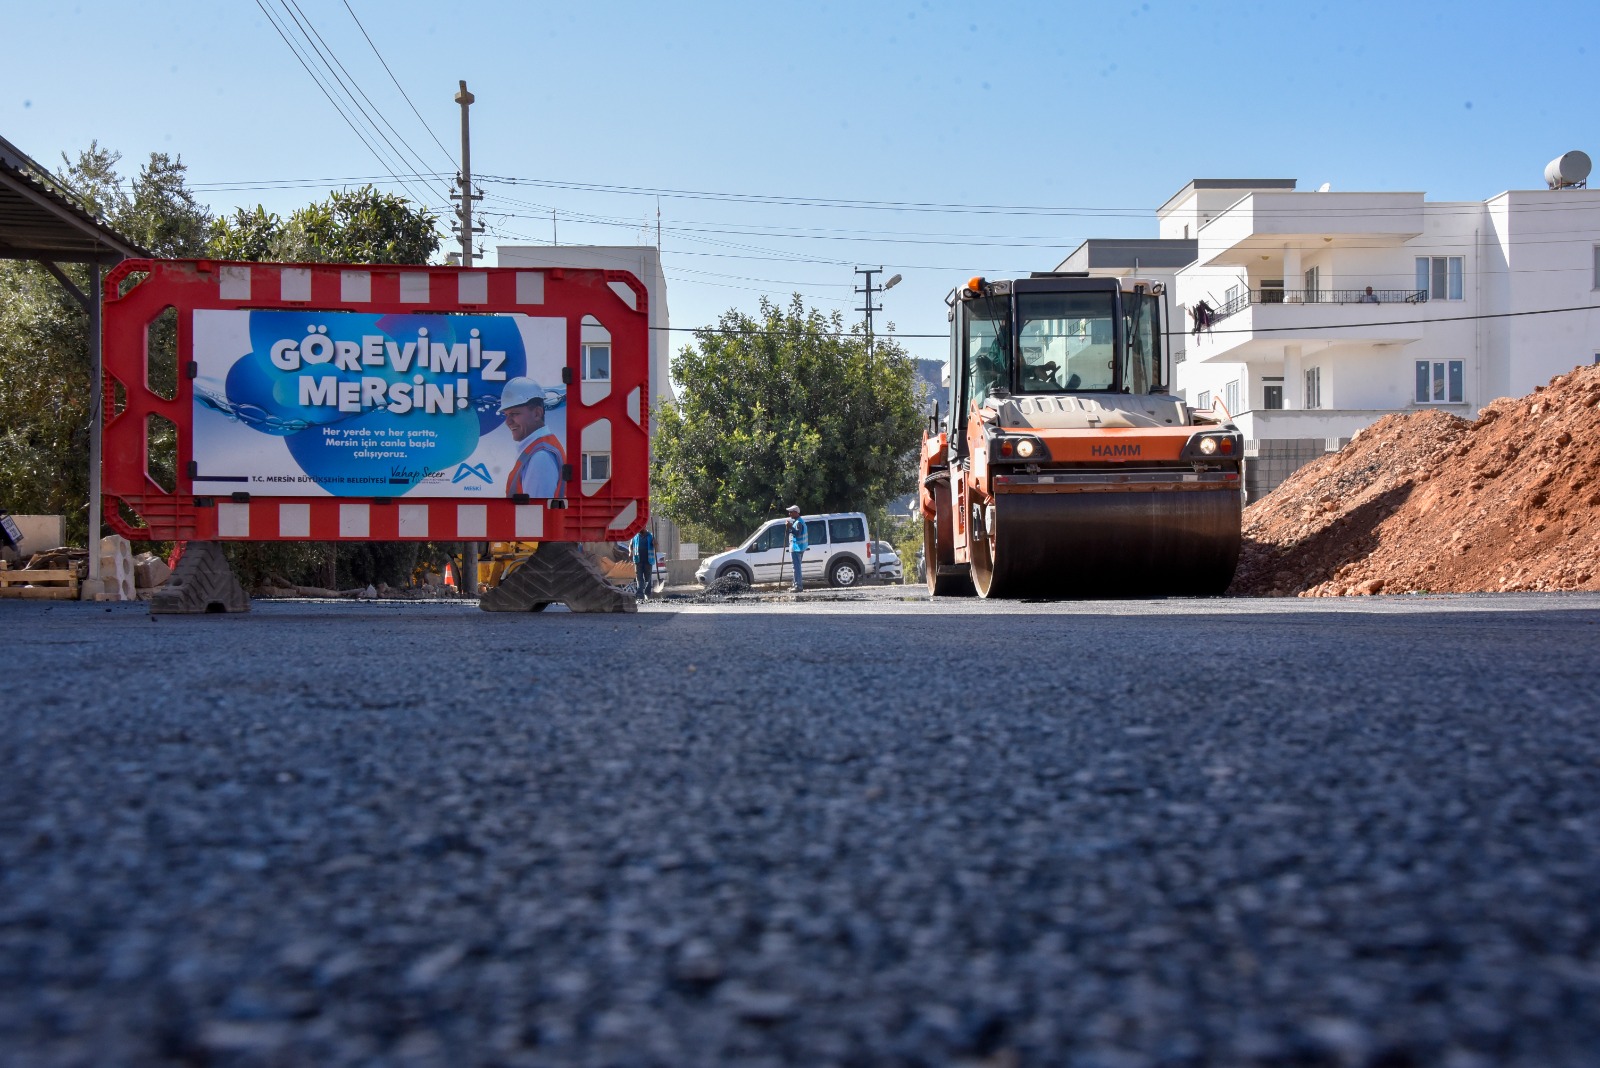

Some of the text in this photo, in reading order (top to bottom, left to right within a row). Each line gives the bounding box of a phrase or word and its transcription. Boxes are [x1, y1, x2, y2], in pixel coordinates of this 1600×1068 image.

[270, 324, 507, 381] GÖREVİMİZ
[344, 428, 371, 437] yerde
[389, 428, 404, 436] her
[407, 429, 438, 438] şartta,
[326, 438, 435, 449] Mersin için canla başla
[354, 449, 407, 459] çalışıyoruz.
[1091, 445, 1141, 456] HAMM
[391, 465, 419, 482] Vahap
[298, 475, 344, 484] BÜYÜKŞEHİR
[347, 476, 386, 484] BELEDİYESİ
